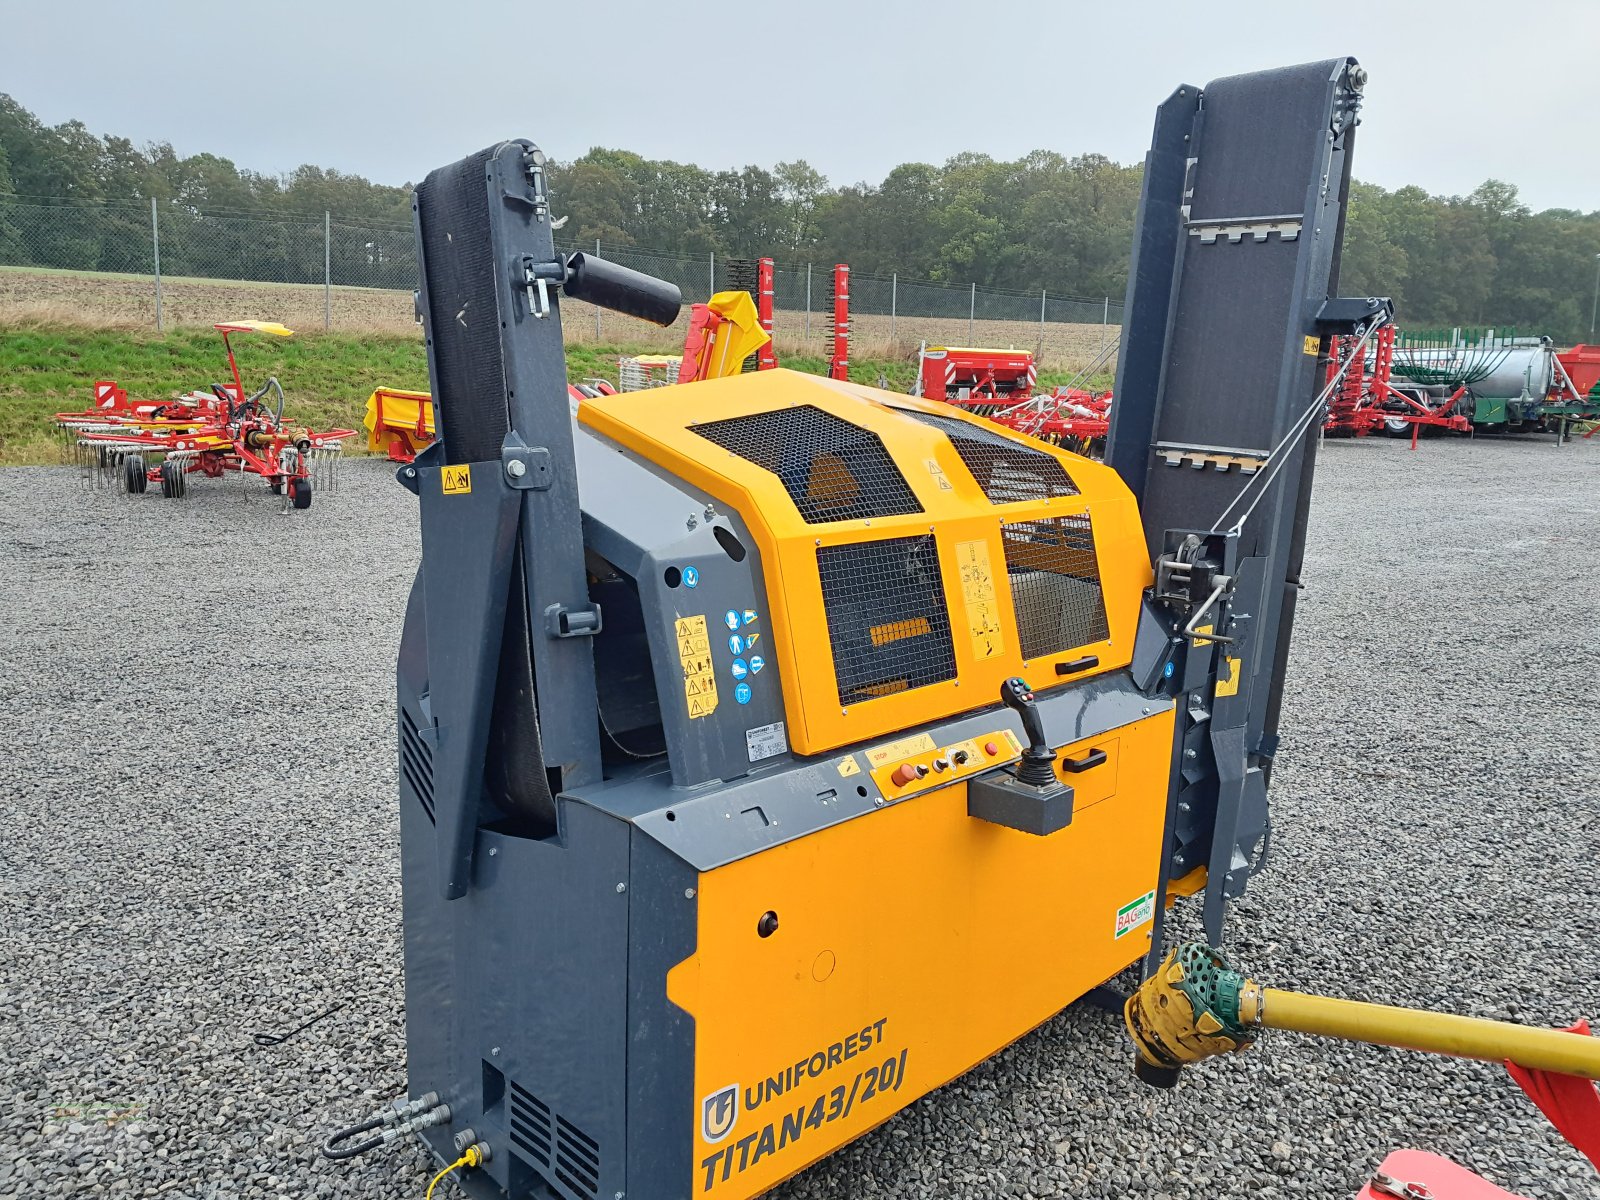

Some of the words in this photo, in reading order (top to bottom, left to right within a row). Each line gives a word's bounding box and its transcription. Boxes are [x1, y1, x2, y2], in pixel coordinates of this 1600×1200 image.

[874, 752, 887, 760] STOP
[745, 1018, 887, 1111] UNIFOREST
[702, 1049, 908, 1192] TITAN43/20J
